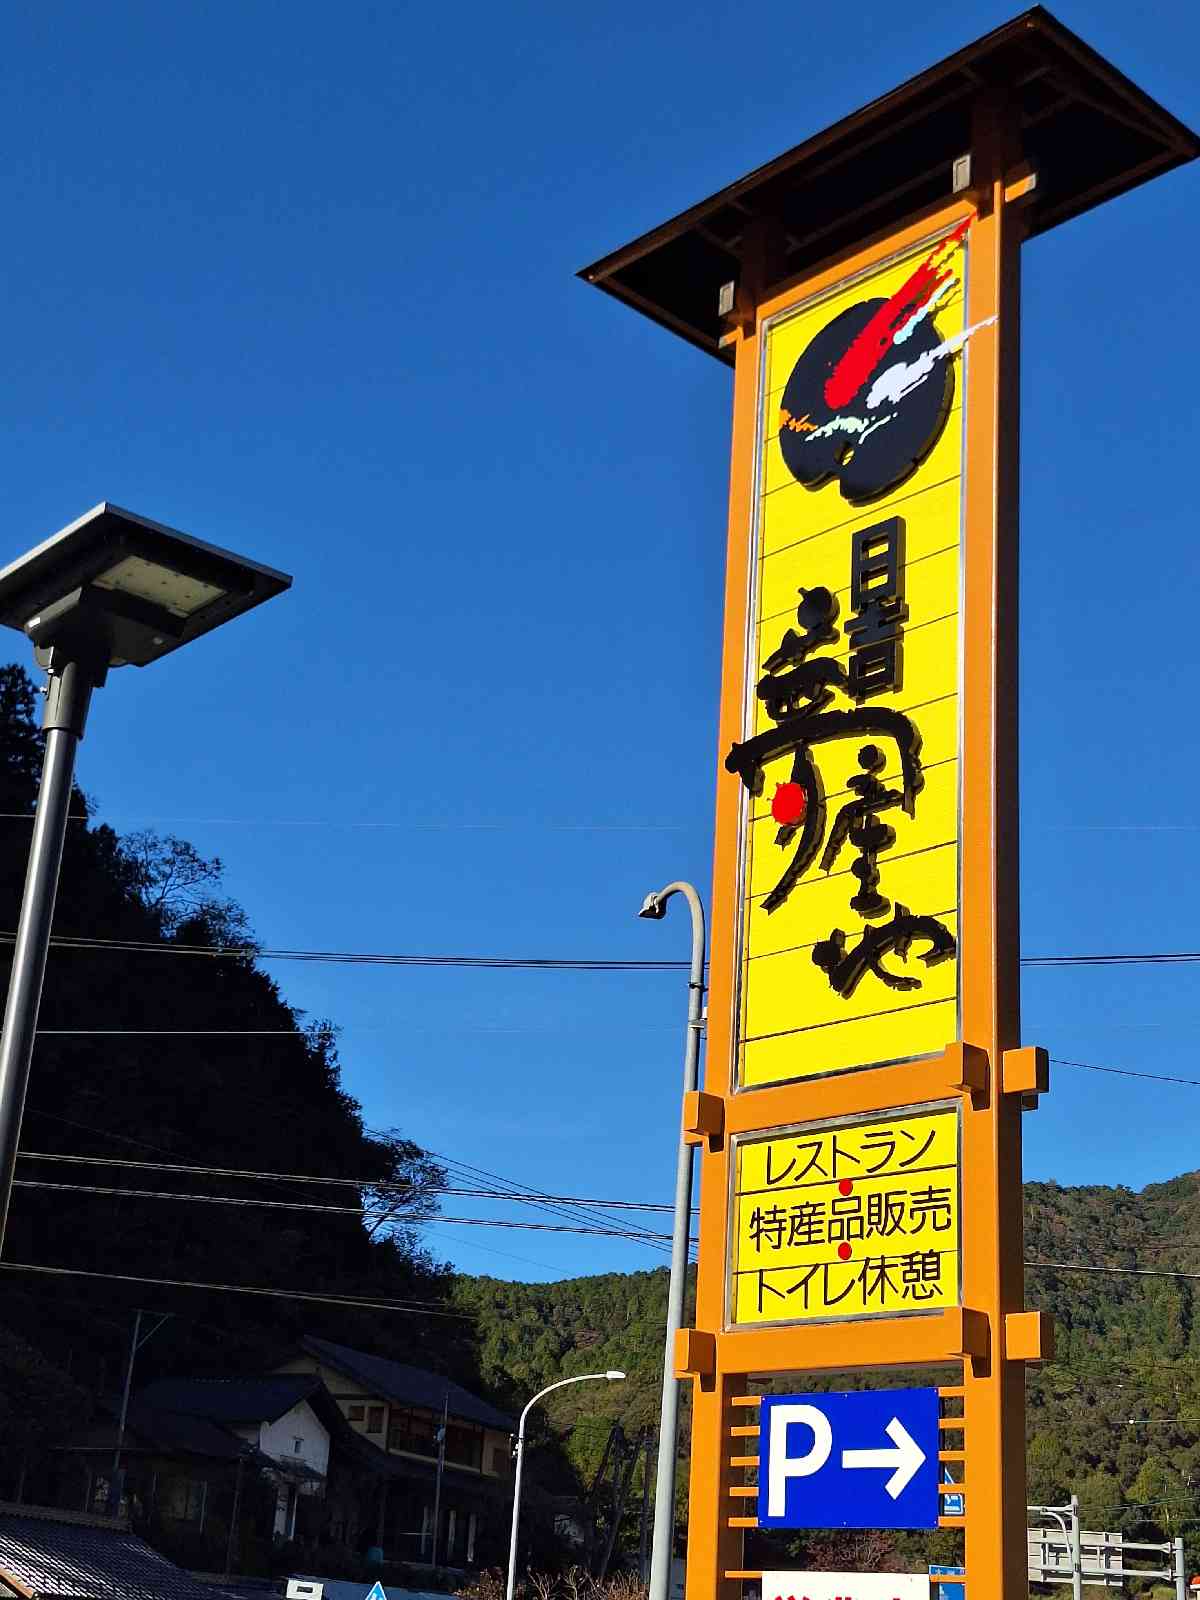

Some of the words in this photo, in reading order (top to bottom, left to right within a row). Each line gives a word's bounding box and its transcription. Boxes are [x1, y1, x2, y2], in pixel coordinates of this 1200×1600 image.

[766, 1129, 936, 1185] レストラン
[749, 1185, 952, 1252] 特産品販売
[757, 1249, 943, 1313] トイレ休憩
[767, 1404, 833, 1517] P
